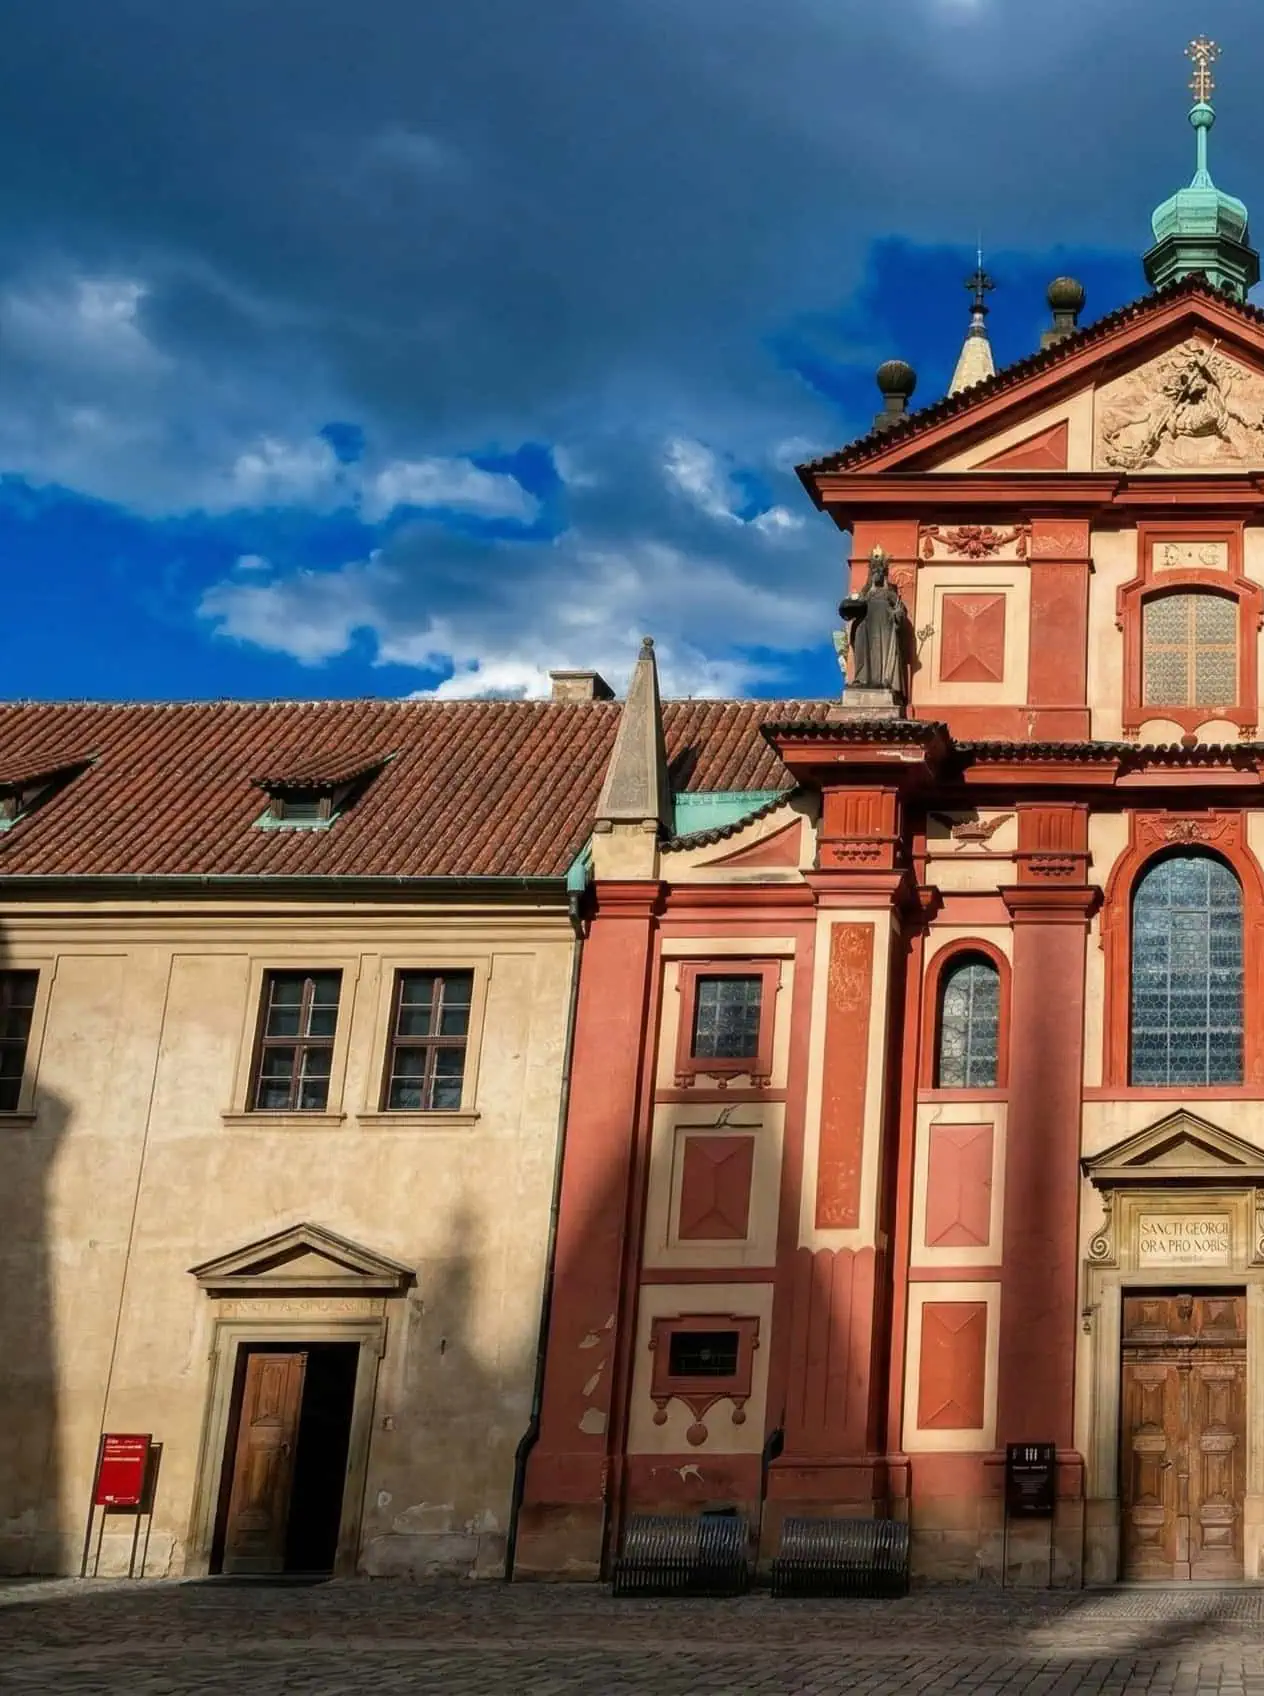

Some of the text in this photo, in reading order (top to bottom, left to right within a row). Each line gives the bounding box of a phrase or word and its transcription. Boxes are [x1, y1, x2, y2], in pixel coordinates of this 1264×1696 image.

[1141, 1222, 1183, 1236] SANCTI
[1141, 1239, 1228, 1253] ORA PRO NOBIS
